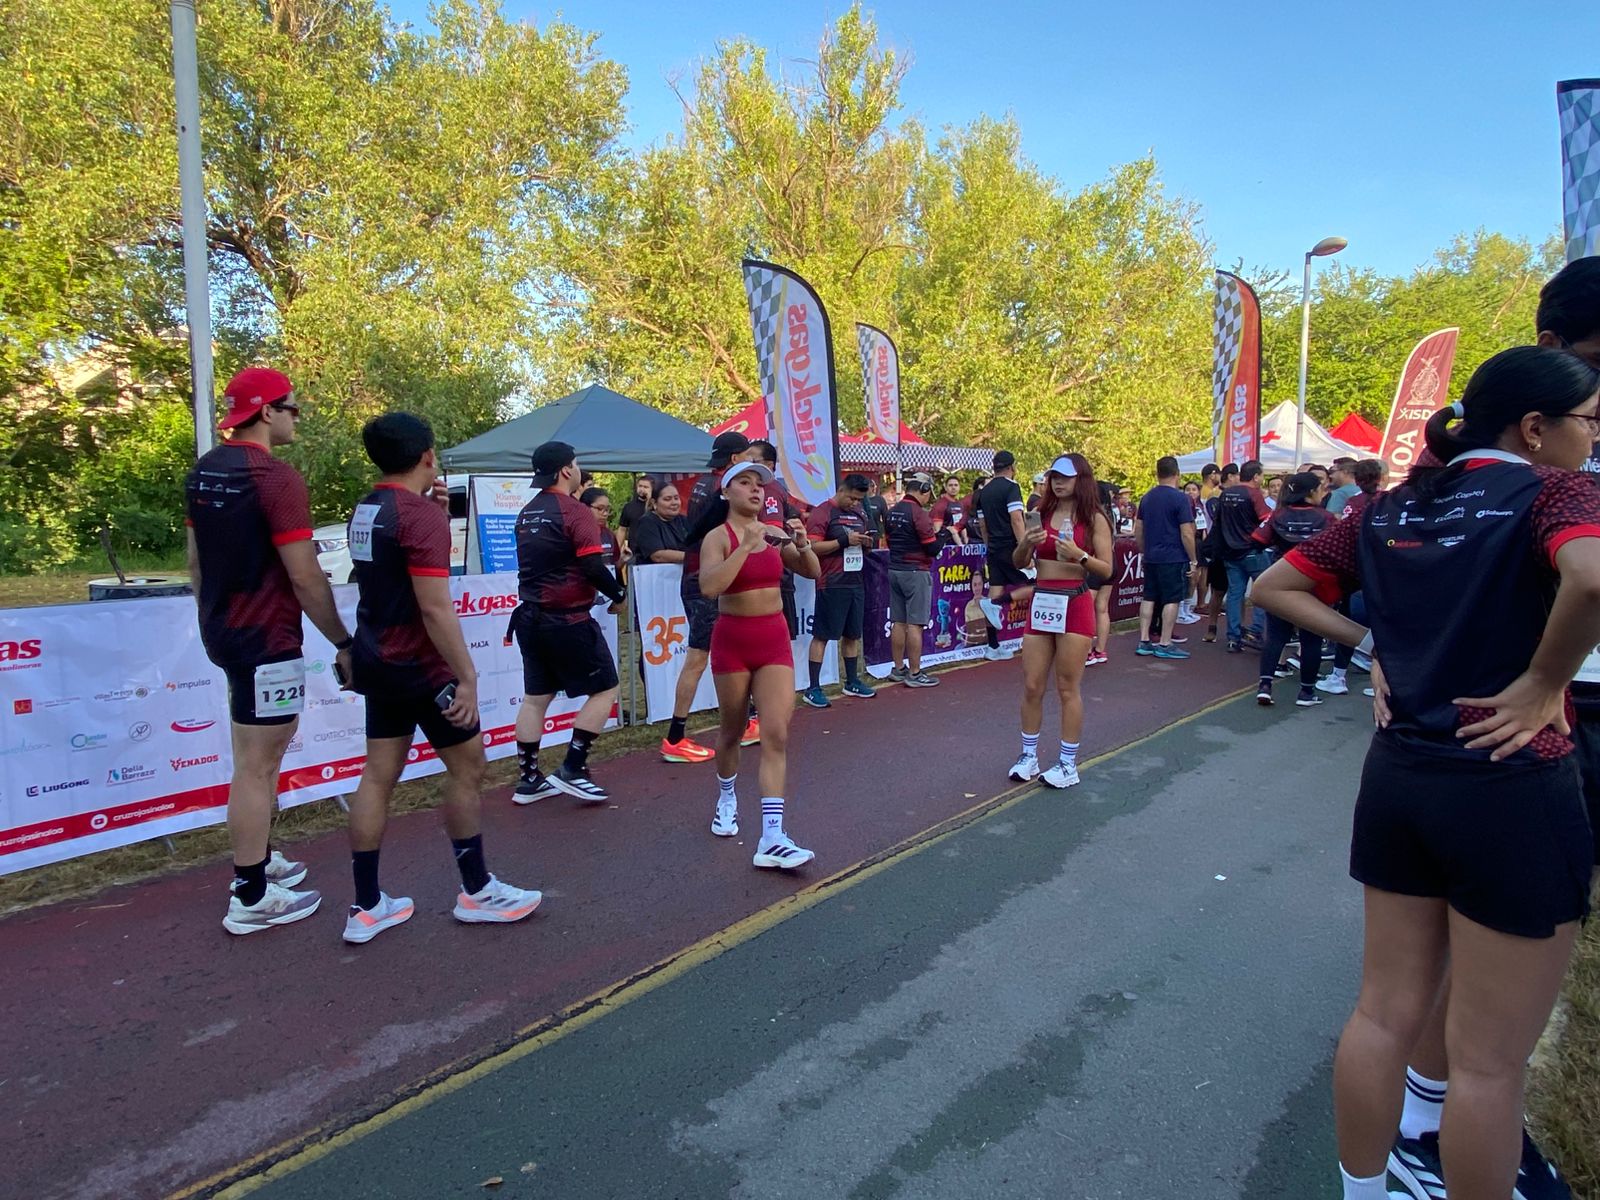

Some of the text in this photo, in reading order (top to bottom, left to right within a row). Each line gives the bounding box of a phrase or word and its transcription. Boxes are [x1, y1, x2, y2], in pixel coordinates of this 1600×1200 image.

[961, 544, 987, 557] Totalp
[938, 564, 971, 583] TAREA
[452, 592, 518, 615] ck gas
[1034, 610, 1063, 622] 0659
[645, 615, 686, 665] 35
[0, 639, 42, 662] as
[178, 679, 211, 690] impulsa
[262, 684, 305, 703] 1228
[170, 754, 219, 771] VENADOS
[0, 827, 64, 846] ruzrojasinaloa
